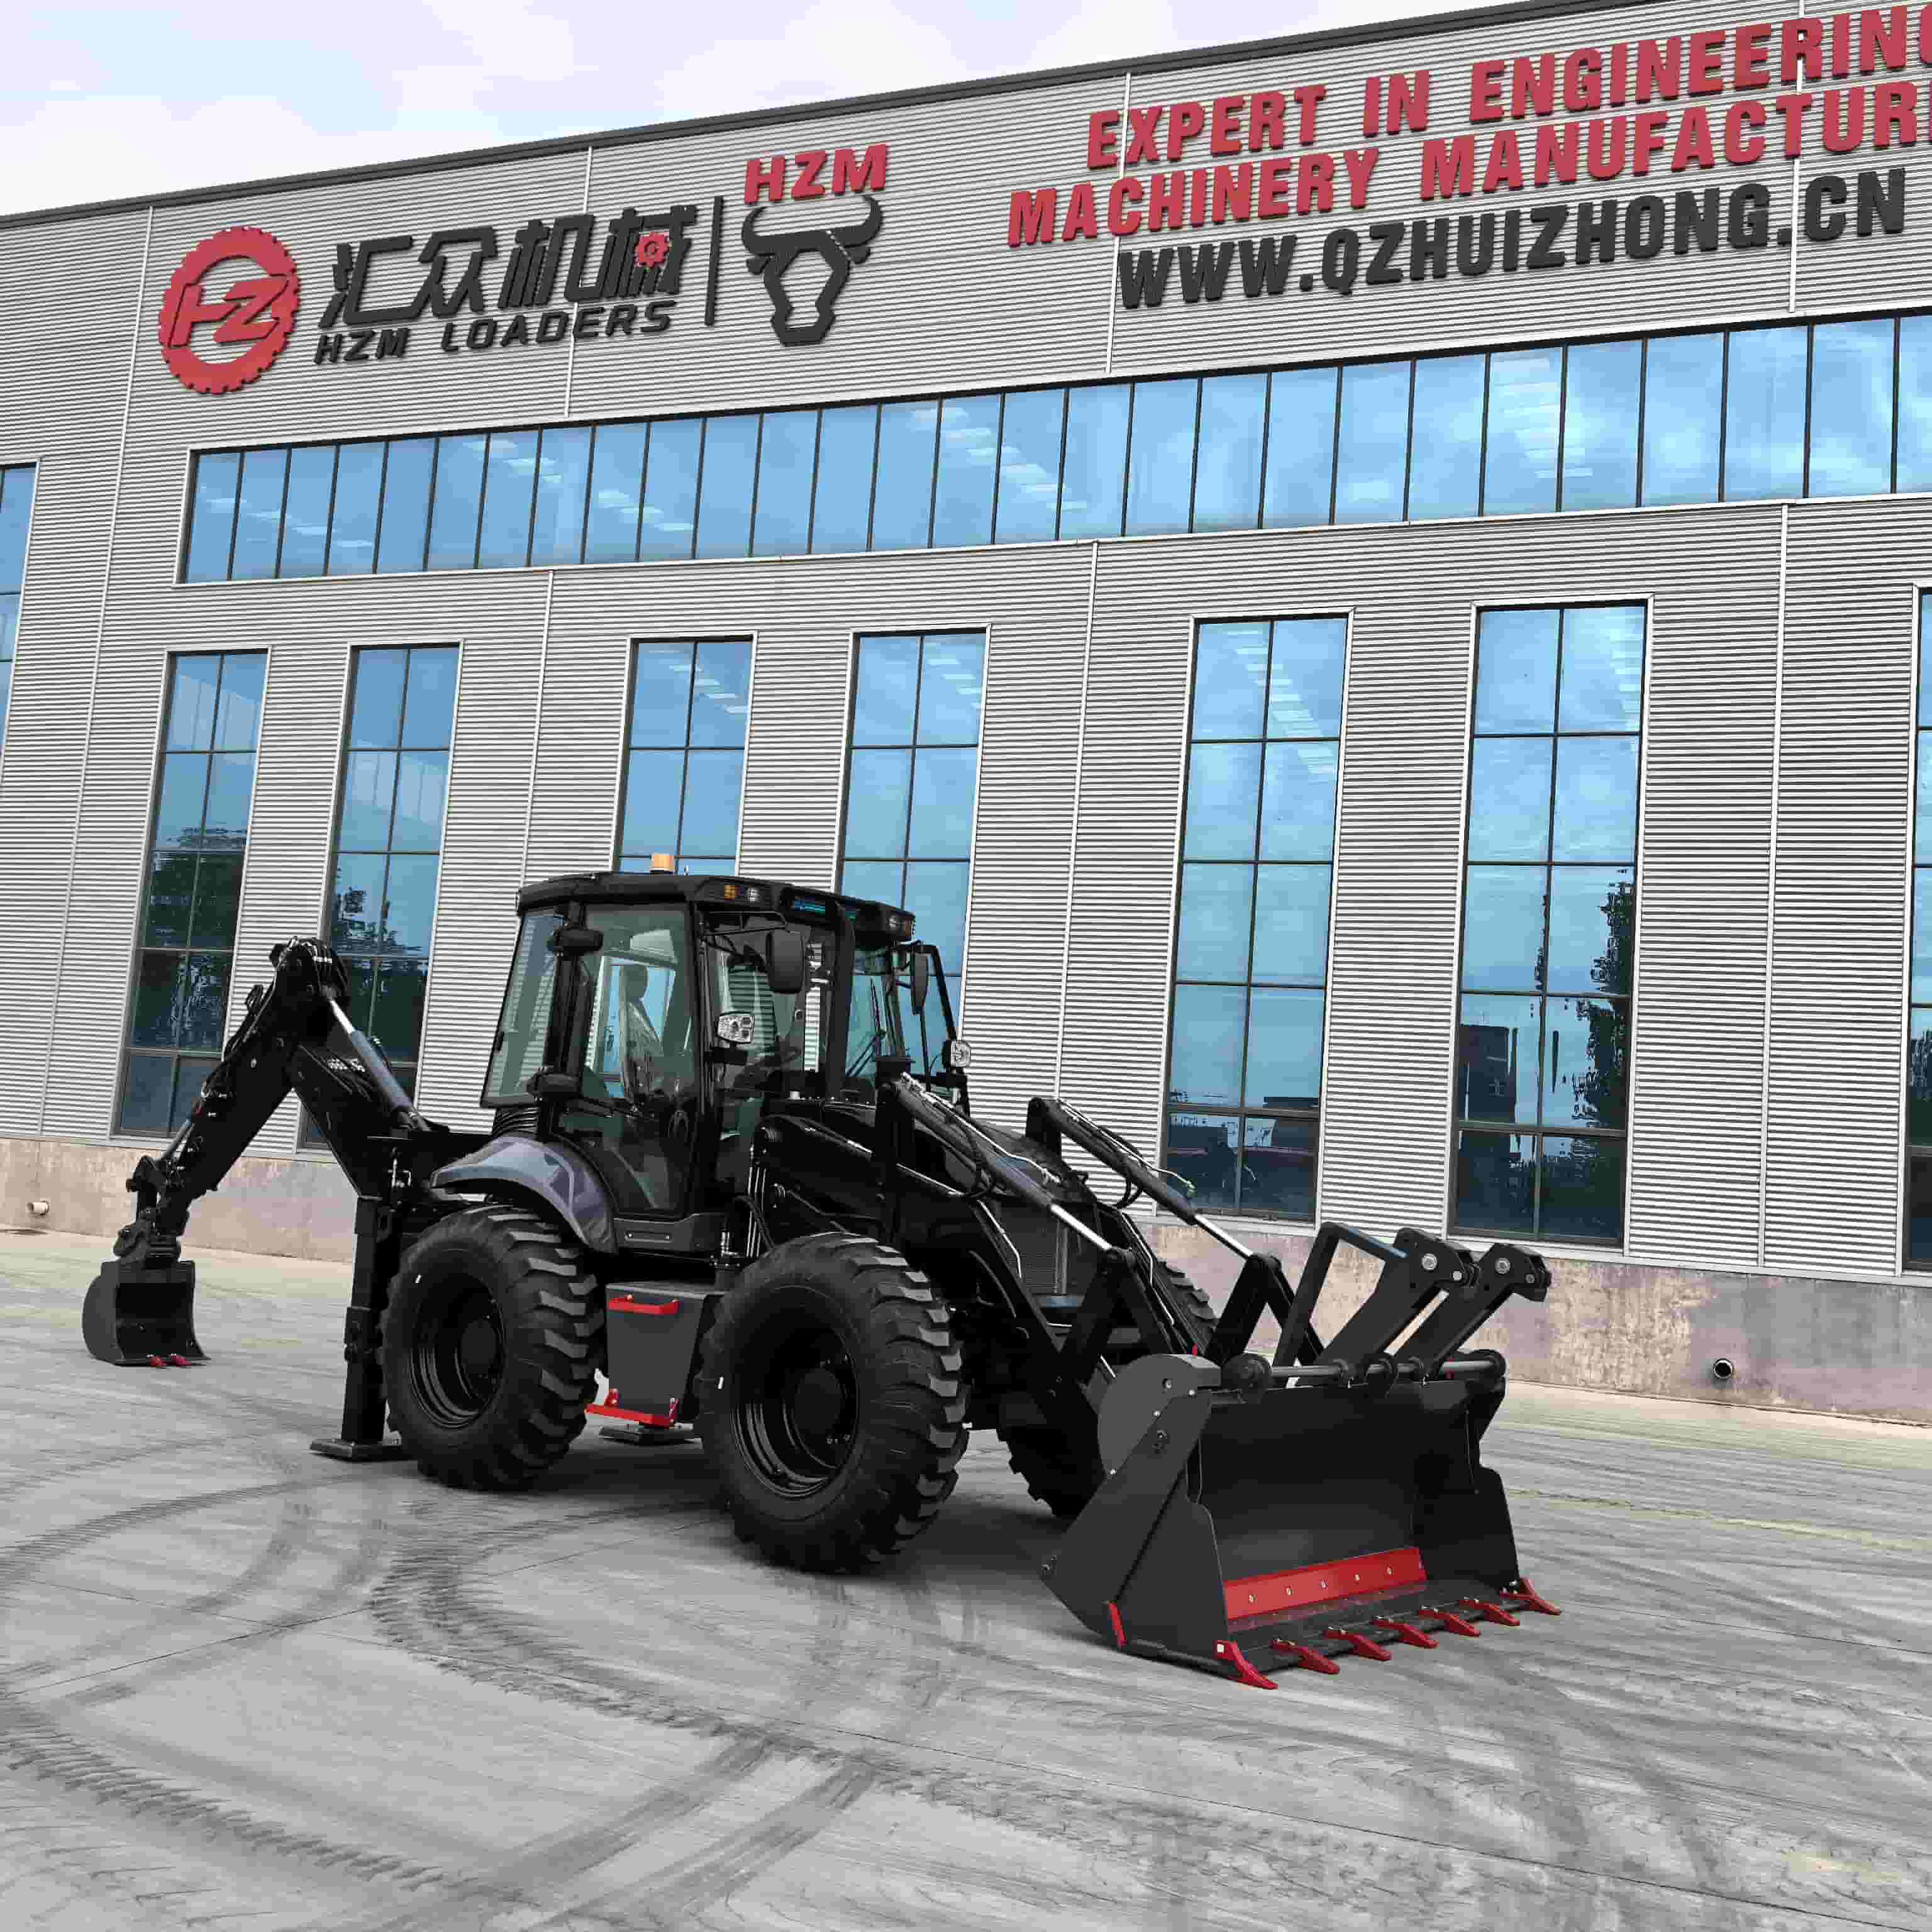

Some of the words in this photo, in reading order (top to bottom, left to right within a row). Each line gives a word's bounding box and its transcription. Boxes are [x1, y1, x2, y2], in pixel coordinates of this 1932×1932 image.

[744, 144, 887, 205] HZM
[1007, 147, 1379, 248] MACHINERY
[1420, 80, 1932, 201] MANUFACTUR
[1086, 84, 1326, 170] EXPERT
[1362, 69, 1430, 137] IN
[318, 205, 698, 329] 汇众机械
[1118, 167, 1906, 309] WWW.QZHUIZHONG.CN
[314, 328, 410, 364] HZM
[441, 301, 677, 352] LOADERS
